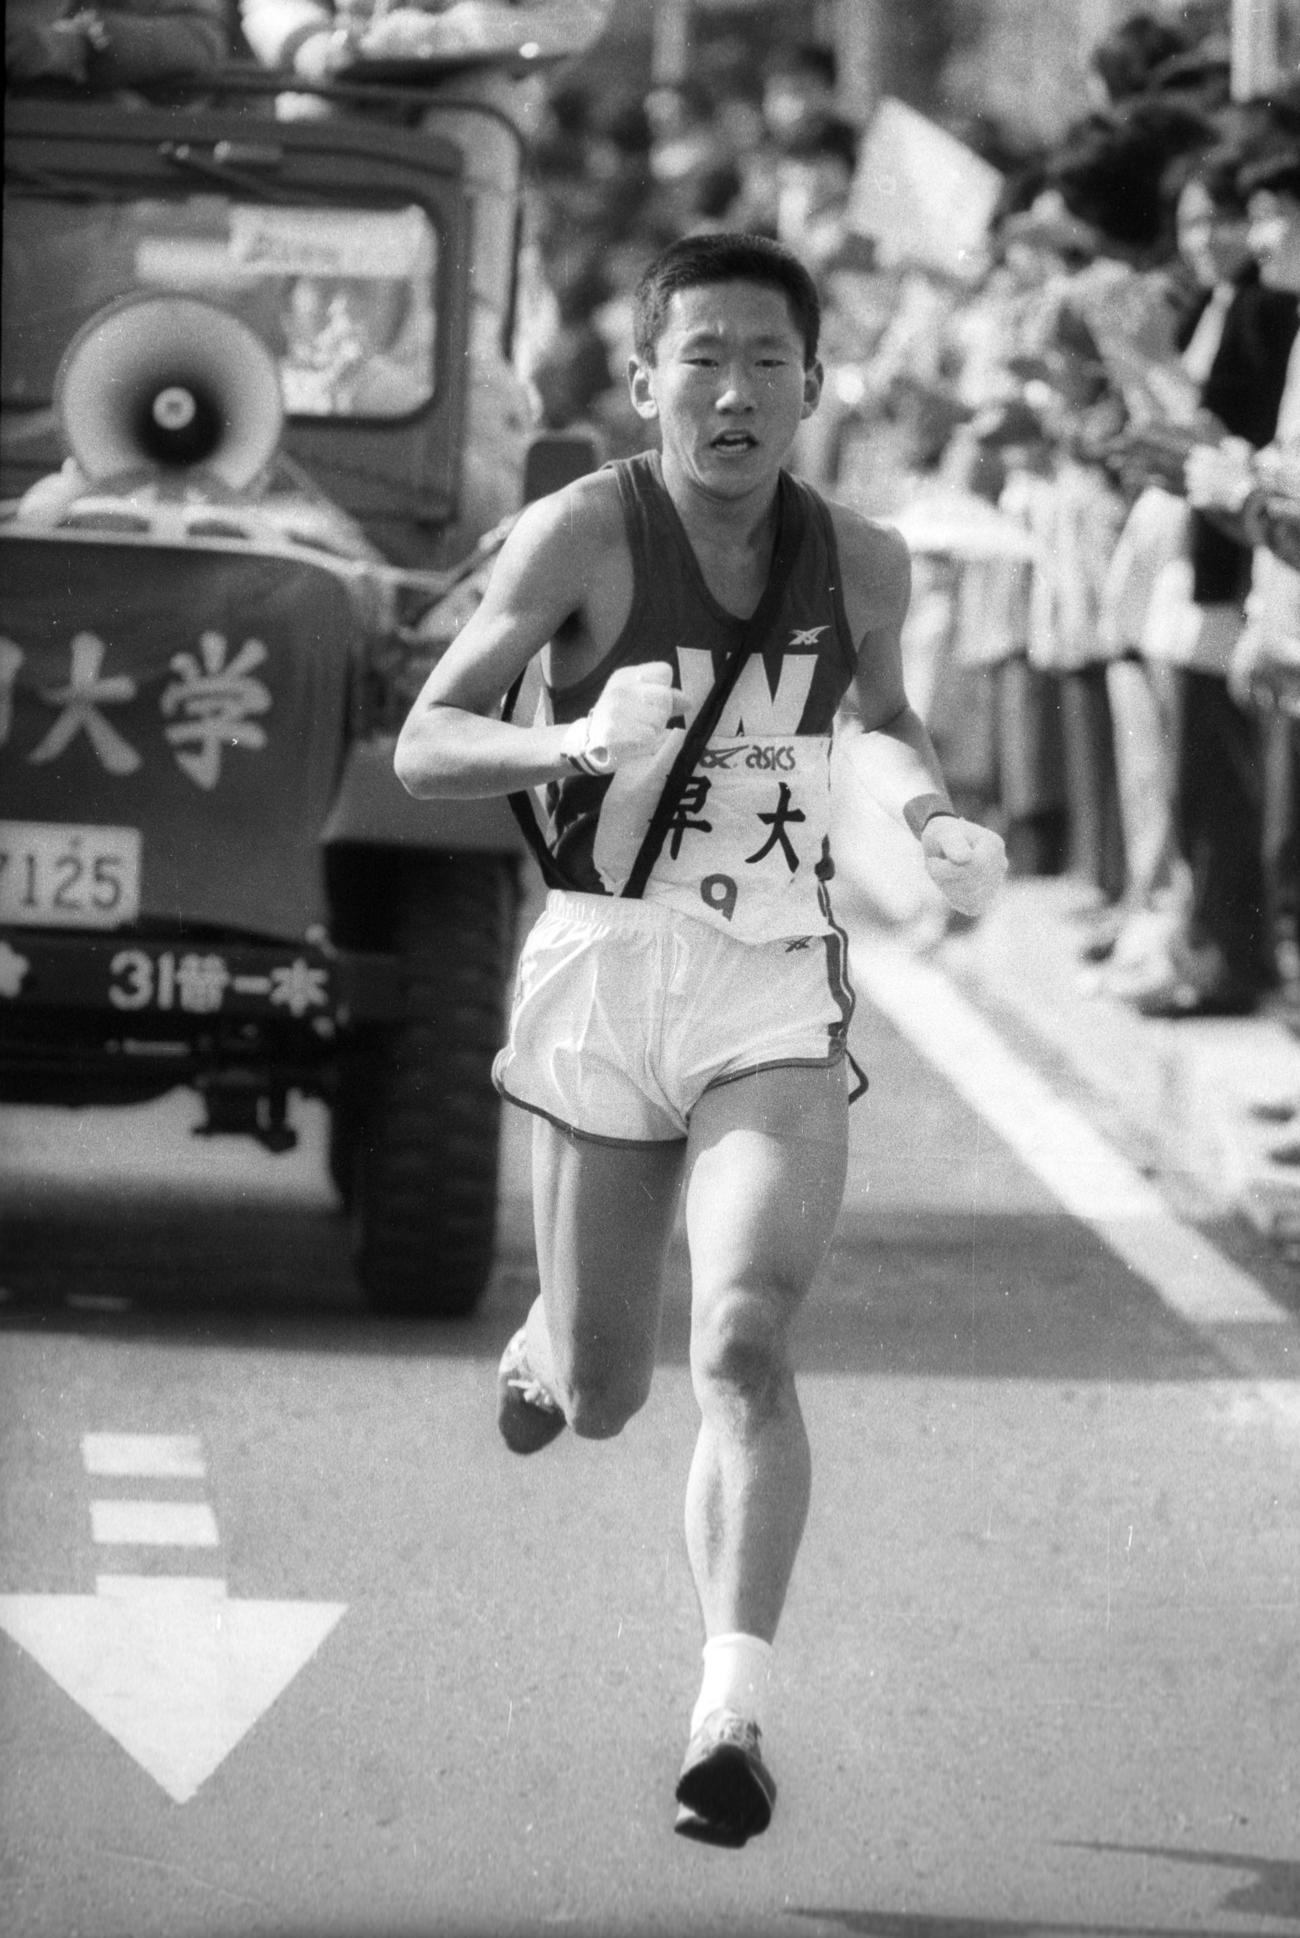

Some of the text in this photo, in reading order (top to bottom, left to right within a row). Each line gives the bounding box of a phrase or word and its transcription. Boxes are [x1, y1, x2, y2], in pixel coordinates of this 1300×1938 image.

[0, 631, 271, 790] 大学
[745, 744, 796, 771] asics
[701, 873, 738, 922] 9
